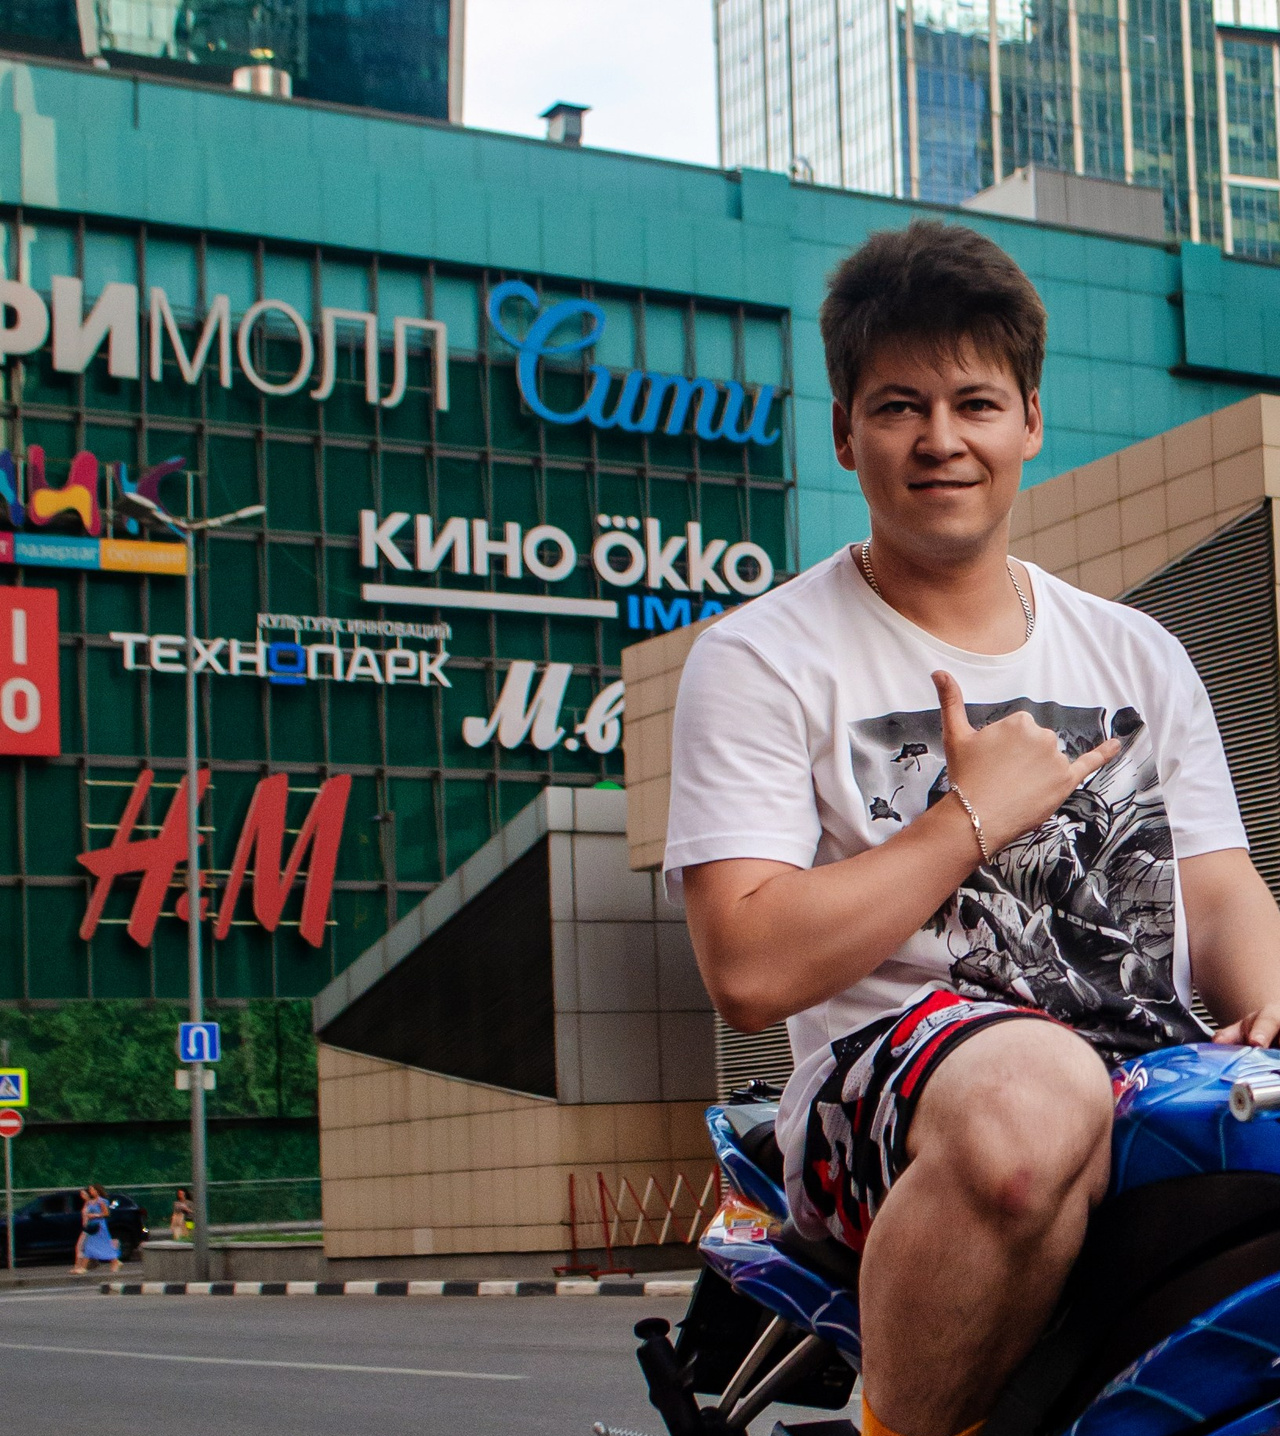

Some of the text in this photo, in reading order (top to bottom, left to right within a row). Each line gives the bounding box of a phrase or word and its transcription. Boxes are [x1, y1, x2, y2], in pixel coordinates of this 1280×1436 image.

[489, 280, 780, 446] Сити
[359, 509, 577, 582] КИНО
[109, 631, 452, 688] ТЕХНОПАРК
[76, 768, 352, 948] H&M
